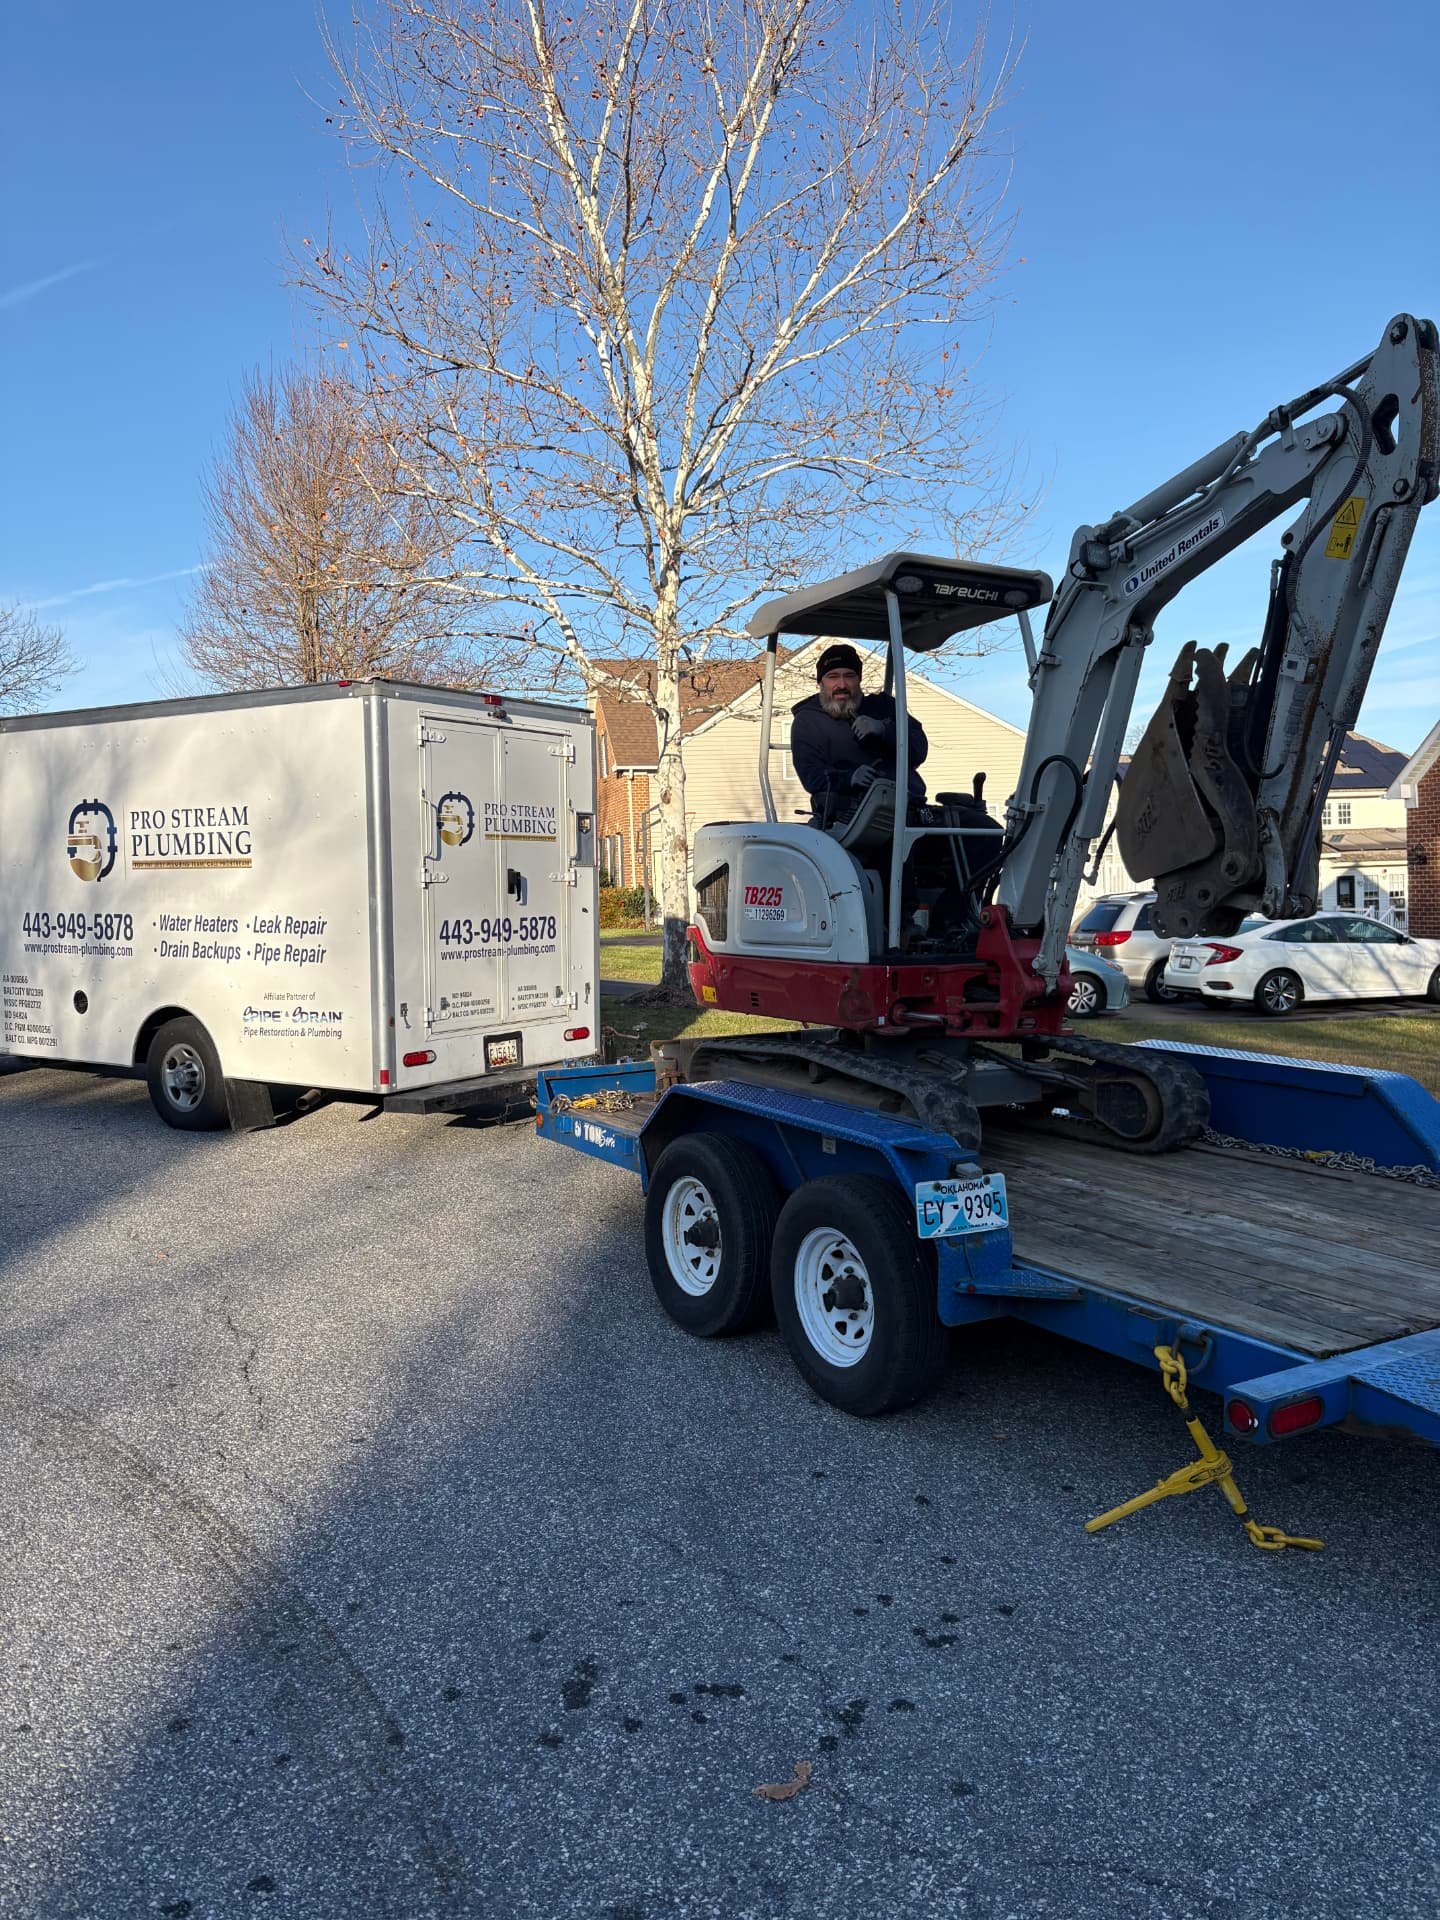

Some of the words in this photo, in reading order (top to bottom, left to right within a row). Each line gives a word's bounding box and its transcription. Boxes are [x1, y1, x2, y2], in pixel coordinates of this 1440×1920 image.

[1140, 548, 1175, 582] United
[1177, 519, 1219, 555] Rentals
[130, 810, 165, 829] PRO
[171, 806, 249, 828] STREAM
[484, 803, 508, 816] PRO
[511, 804, 555, 818] STREAM
[485, 817, 557, 834] PLUMBING
[131, 830, 252, 857] PLUMBING
[744, 886, 784, 906] TB225
[23, 912, 133, 941] 443-949-5878
[159, 914, 192, 932] Water
[194, 914, 239, 933] Heaters
[253, 915, 282, 934] Leak
[284, 915, 327, 939] Repair
[440, 916, 556, 945] 443-949-5878
[24, 943, 133, 959] www.prostream-plumbing.com
[160, 940, 189, 958] Drain
[192, 941, 241, 963] Backups
[254, 943, 280, 966] Pipe
[284, 944, 327, 967] Repair
[441, 944, 556, 962] www.prostream-plumbing.com
[244, 1026, 258, 1038] Pipe
[260, 1027, 299, 1037] Restoration
[307, 1028, 342, 1039] Plumbing
[940, 1182, 984, 1195] OKLAHOMA
[923, 1199, 945, 1225] CY
[964, 1192, 1002, 1220] 9395
